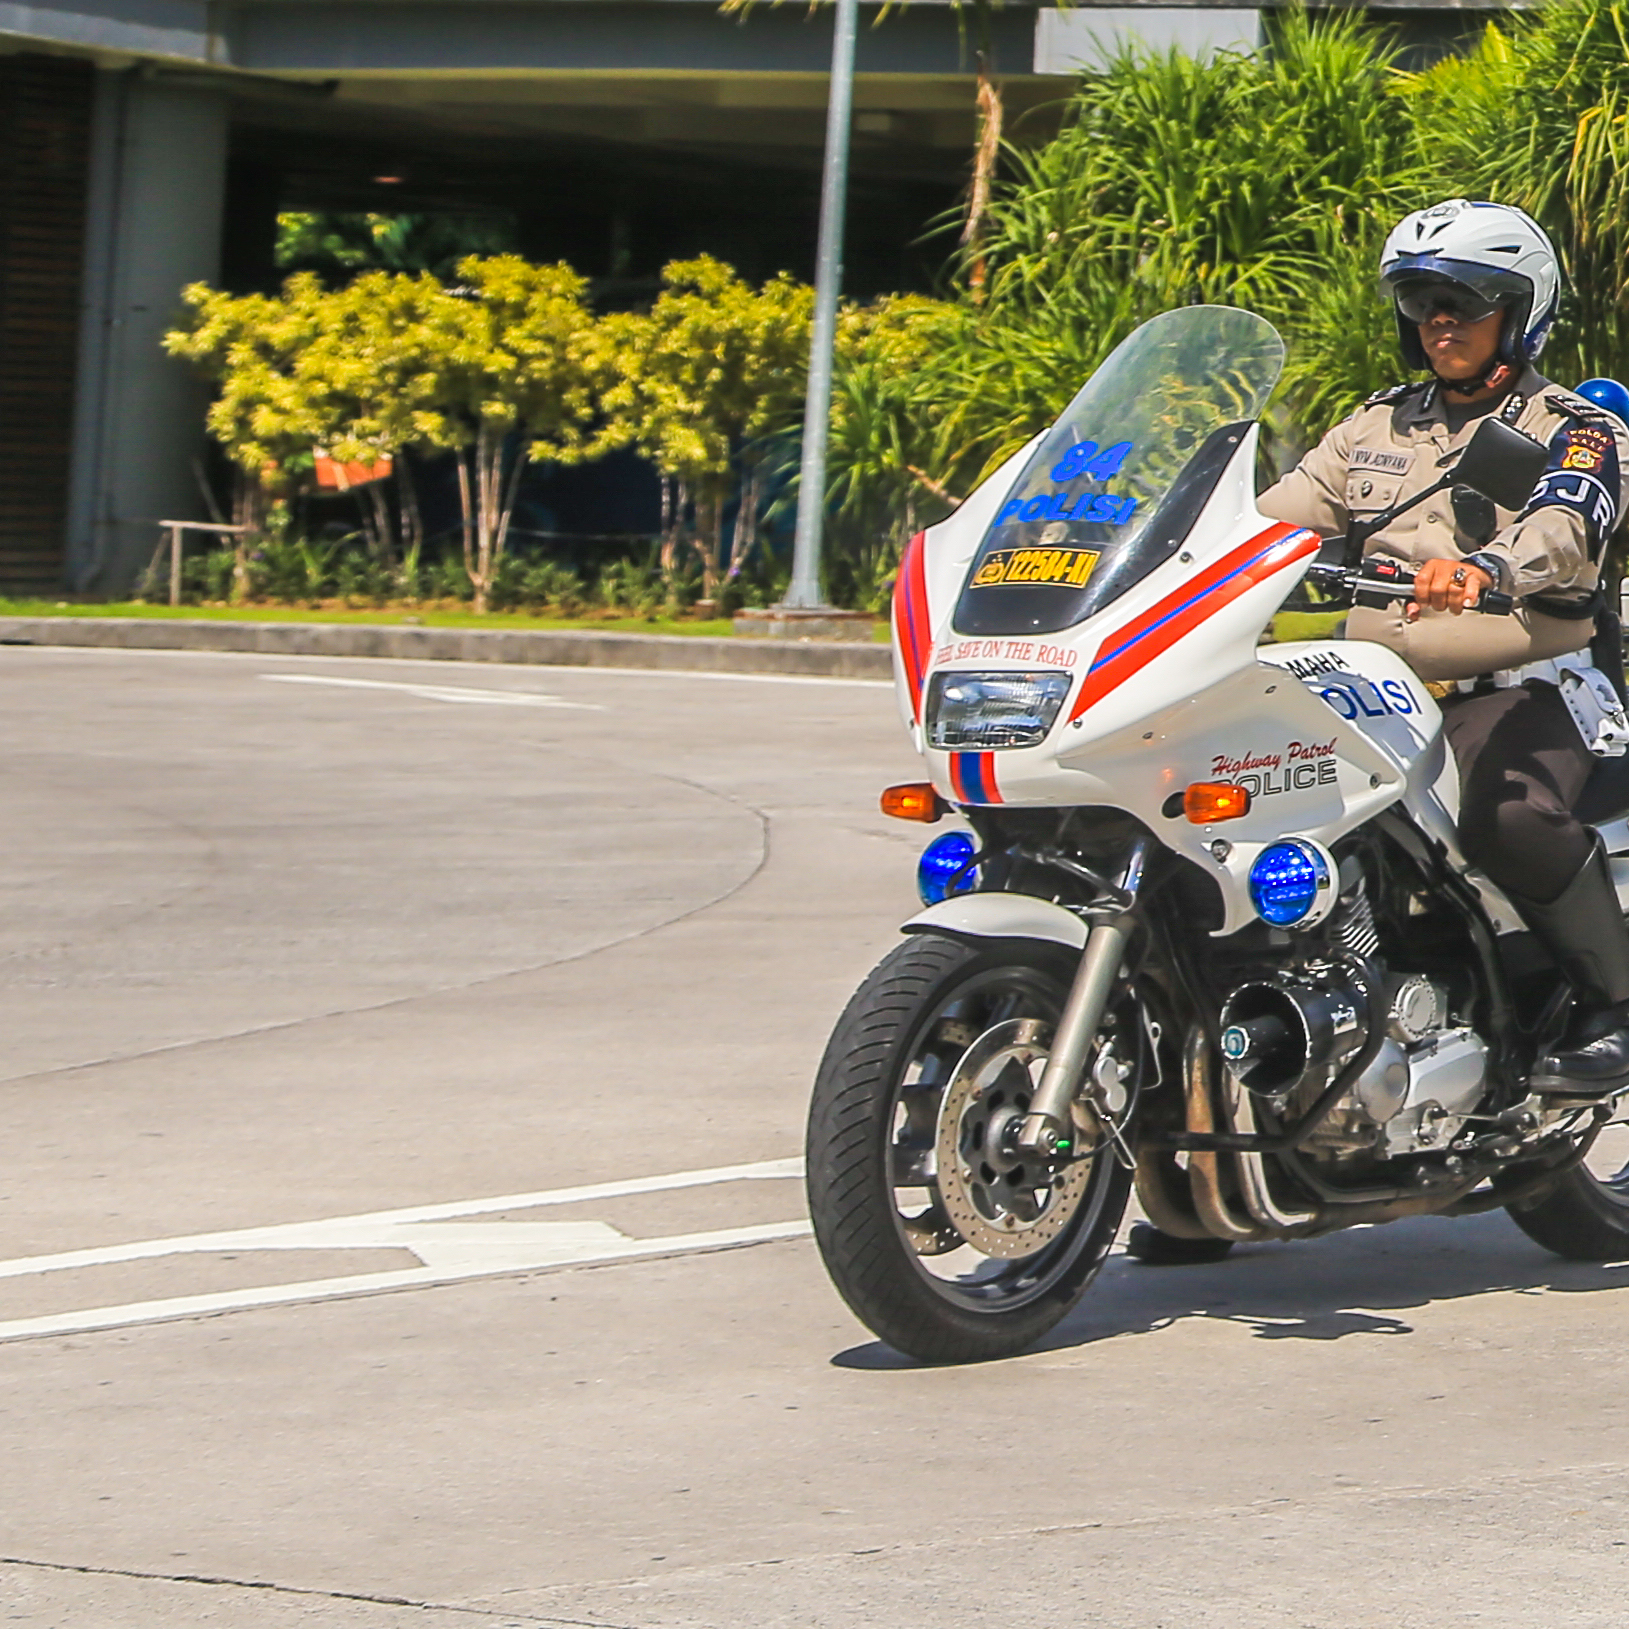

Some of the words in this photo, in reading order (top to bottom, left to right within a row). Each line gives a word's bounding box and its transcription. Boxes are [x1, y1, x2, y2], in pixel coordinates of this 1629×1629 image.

[1051, 441, 1134, 482] 84
[994, 493, 1138, 527] POLISI
[981, 640, 1004, 658] ON
[1003, 641, 1034, 661] THE
[1035, 644, 1078, 668] ROAD
[1286, 651, 1351, 679] MAHA
[1320, 680, 1423, 721] OLISI
[1211, 750, 1282, 780] Highway
[1287, 737, 1338, 764] Patrol
[1212, 759, 1337, 798] OLICE
